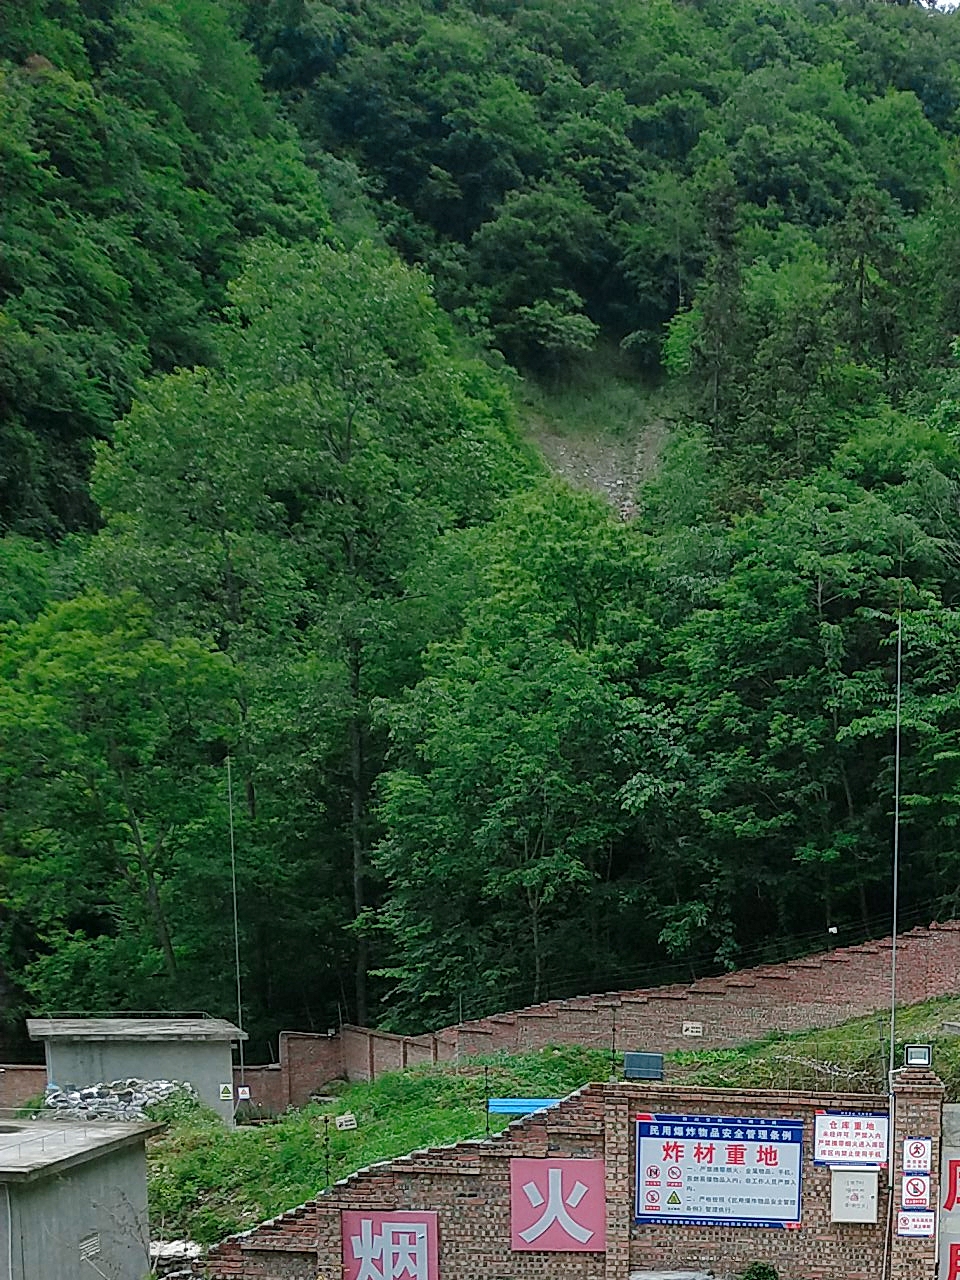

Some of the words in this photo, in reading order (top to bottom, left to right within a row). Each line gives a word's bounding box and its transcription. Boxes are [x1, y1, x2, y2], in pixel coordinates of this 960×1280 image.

[649, 1124, 792, 1141] 民用爆炸物品安全管理条例
[829, 1120, 875, 1131] 仓库重地
[662, 1140, 779, 1167] 炸材重地
